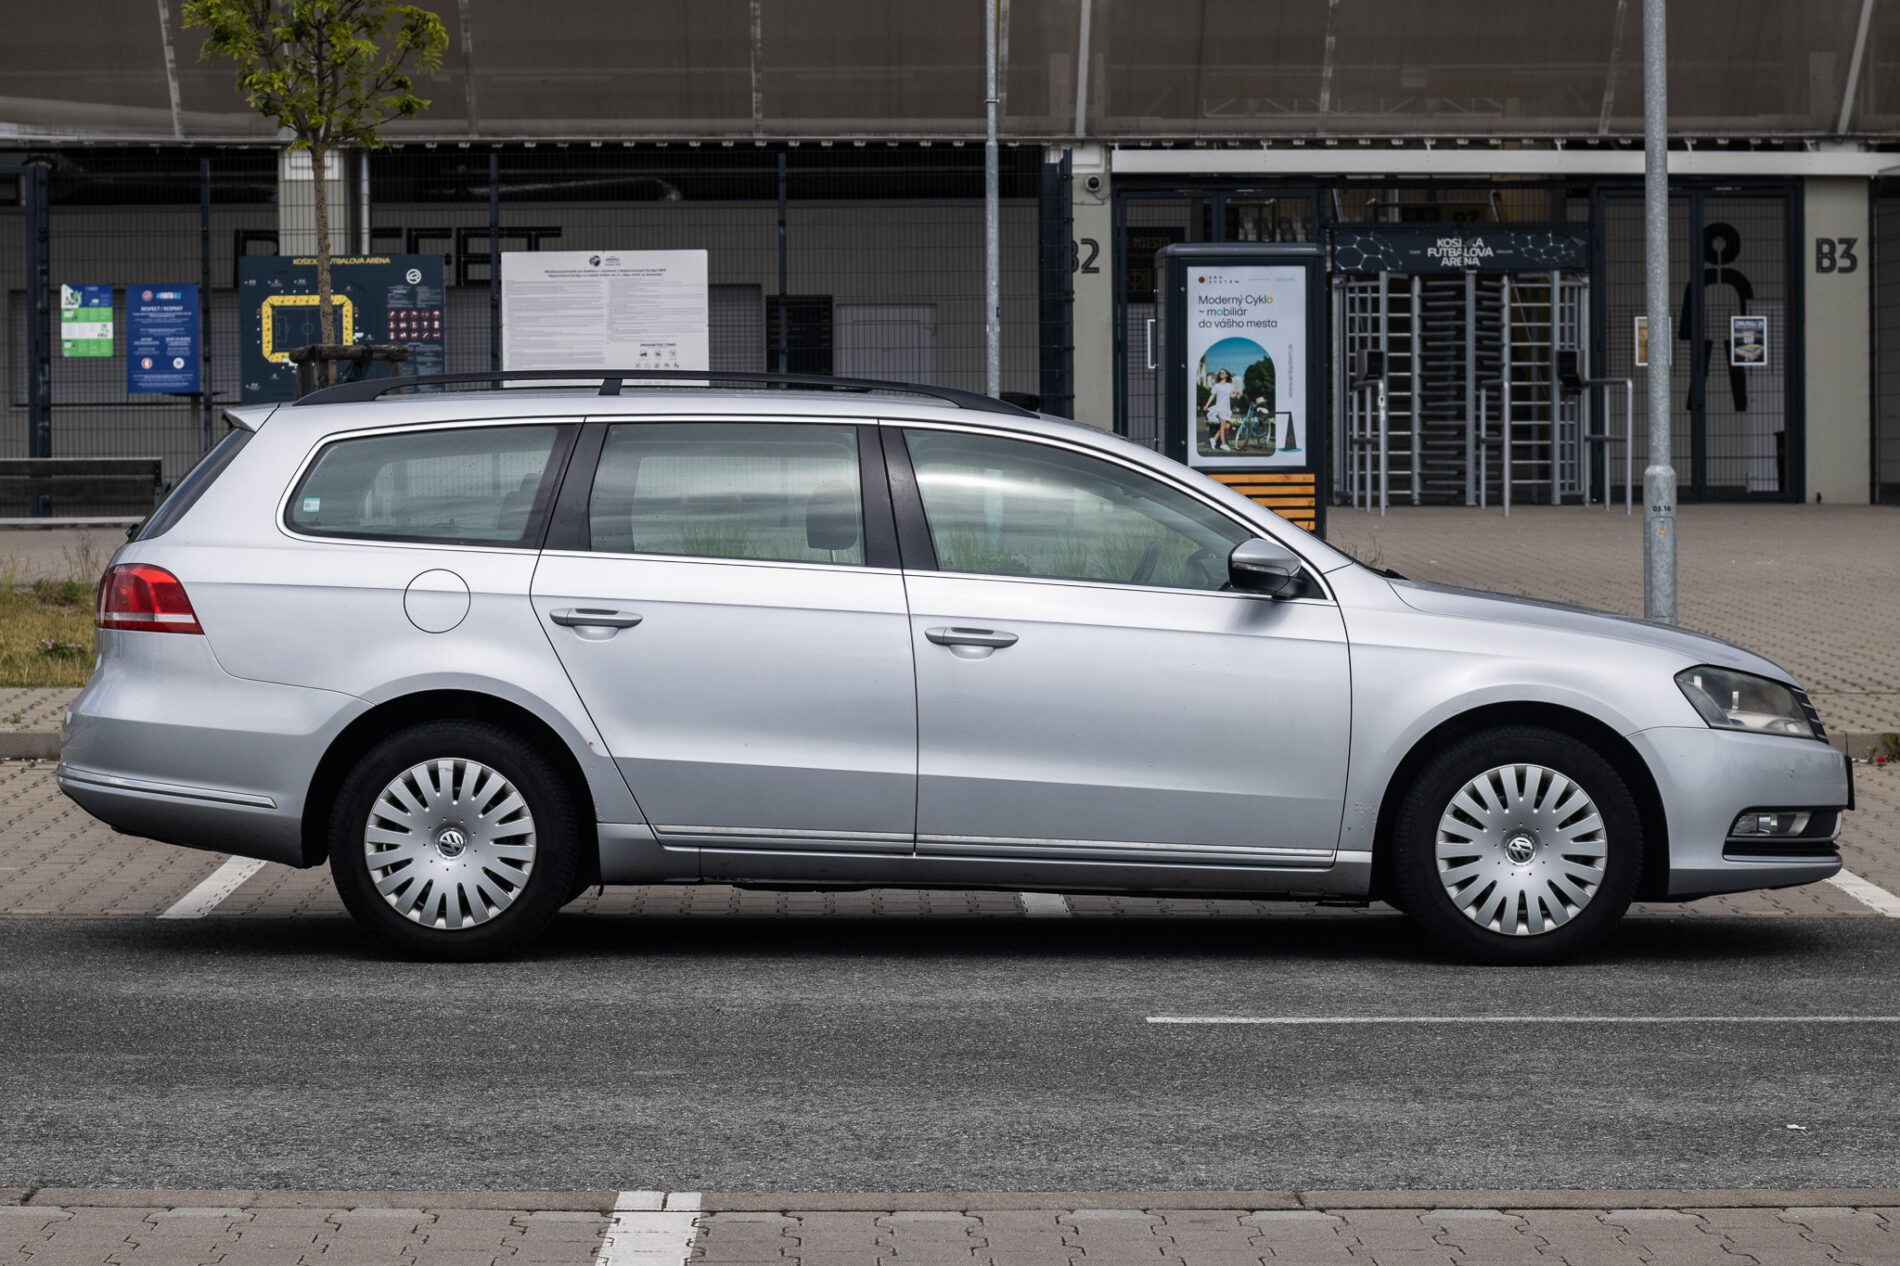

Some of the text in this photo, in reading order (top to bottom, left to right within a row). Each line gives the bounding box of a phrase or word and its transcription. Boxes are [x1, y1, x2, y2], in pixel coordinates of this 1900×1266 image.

[1815, 238, 1858, 274] B3
[1198, 294, 1274, 306] Moderný Cyklo
[1206, 307, 1247, 317] mobiliár
[1198, 318, 1278, 328] do vášho mesta
